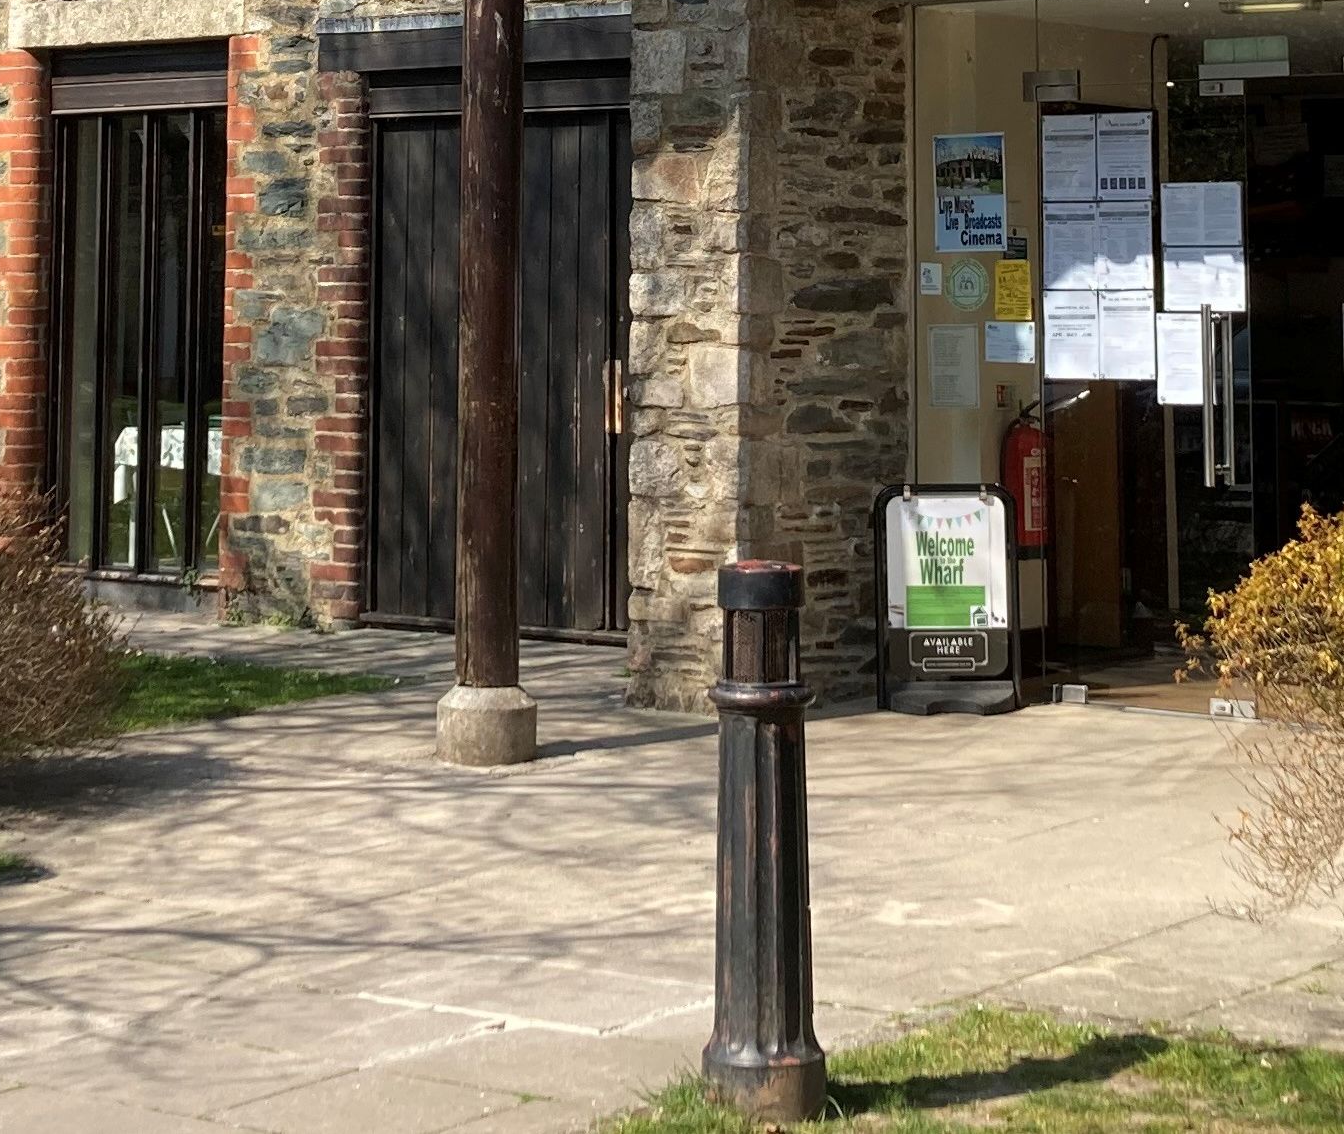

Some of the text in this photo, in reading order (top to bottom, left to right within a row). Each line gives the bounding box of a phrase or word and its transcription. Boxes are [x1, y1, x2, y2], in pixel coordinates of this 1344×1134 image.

[938, 195, 974, 214] Live Music
[945, 213, 1002, 231] Live Broadcasts
[961, 230, 1003, 245] Cinema
[916, 531, 974, 557] Welcome
[920, 558, 964, 584] Wharf
[923, 637, 974, 647] AVAILABLE
[937, 646, 960, 655] HERE
